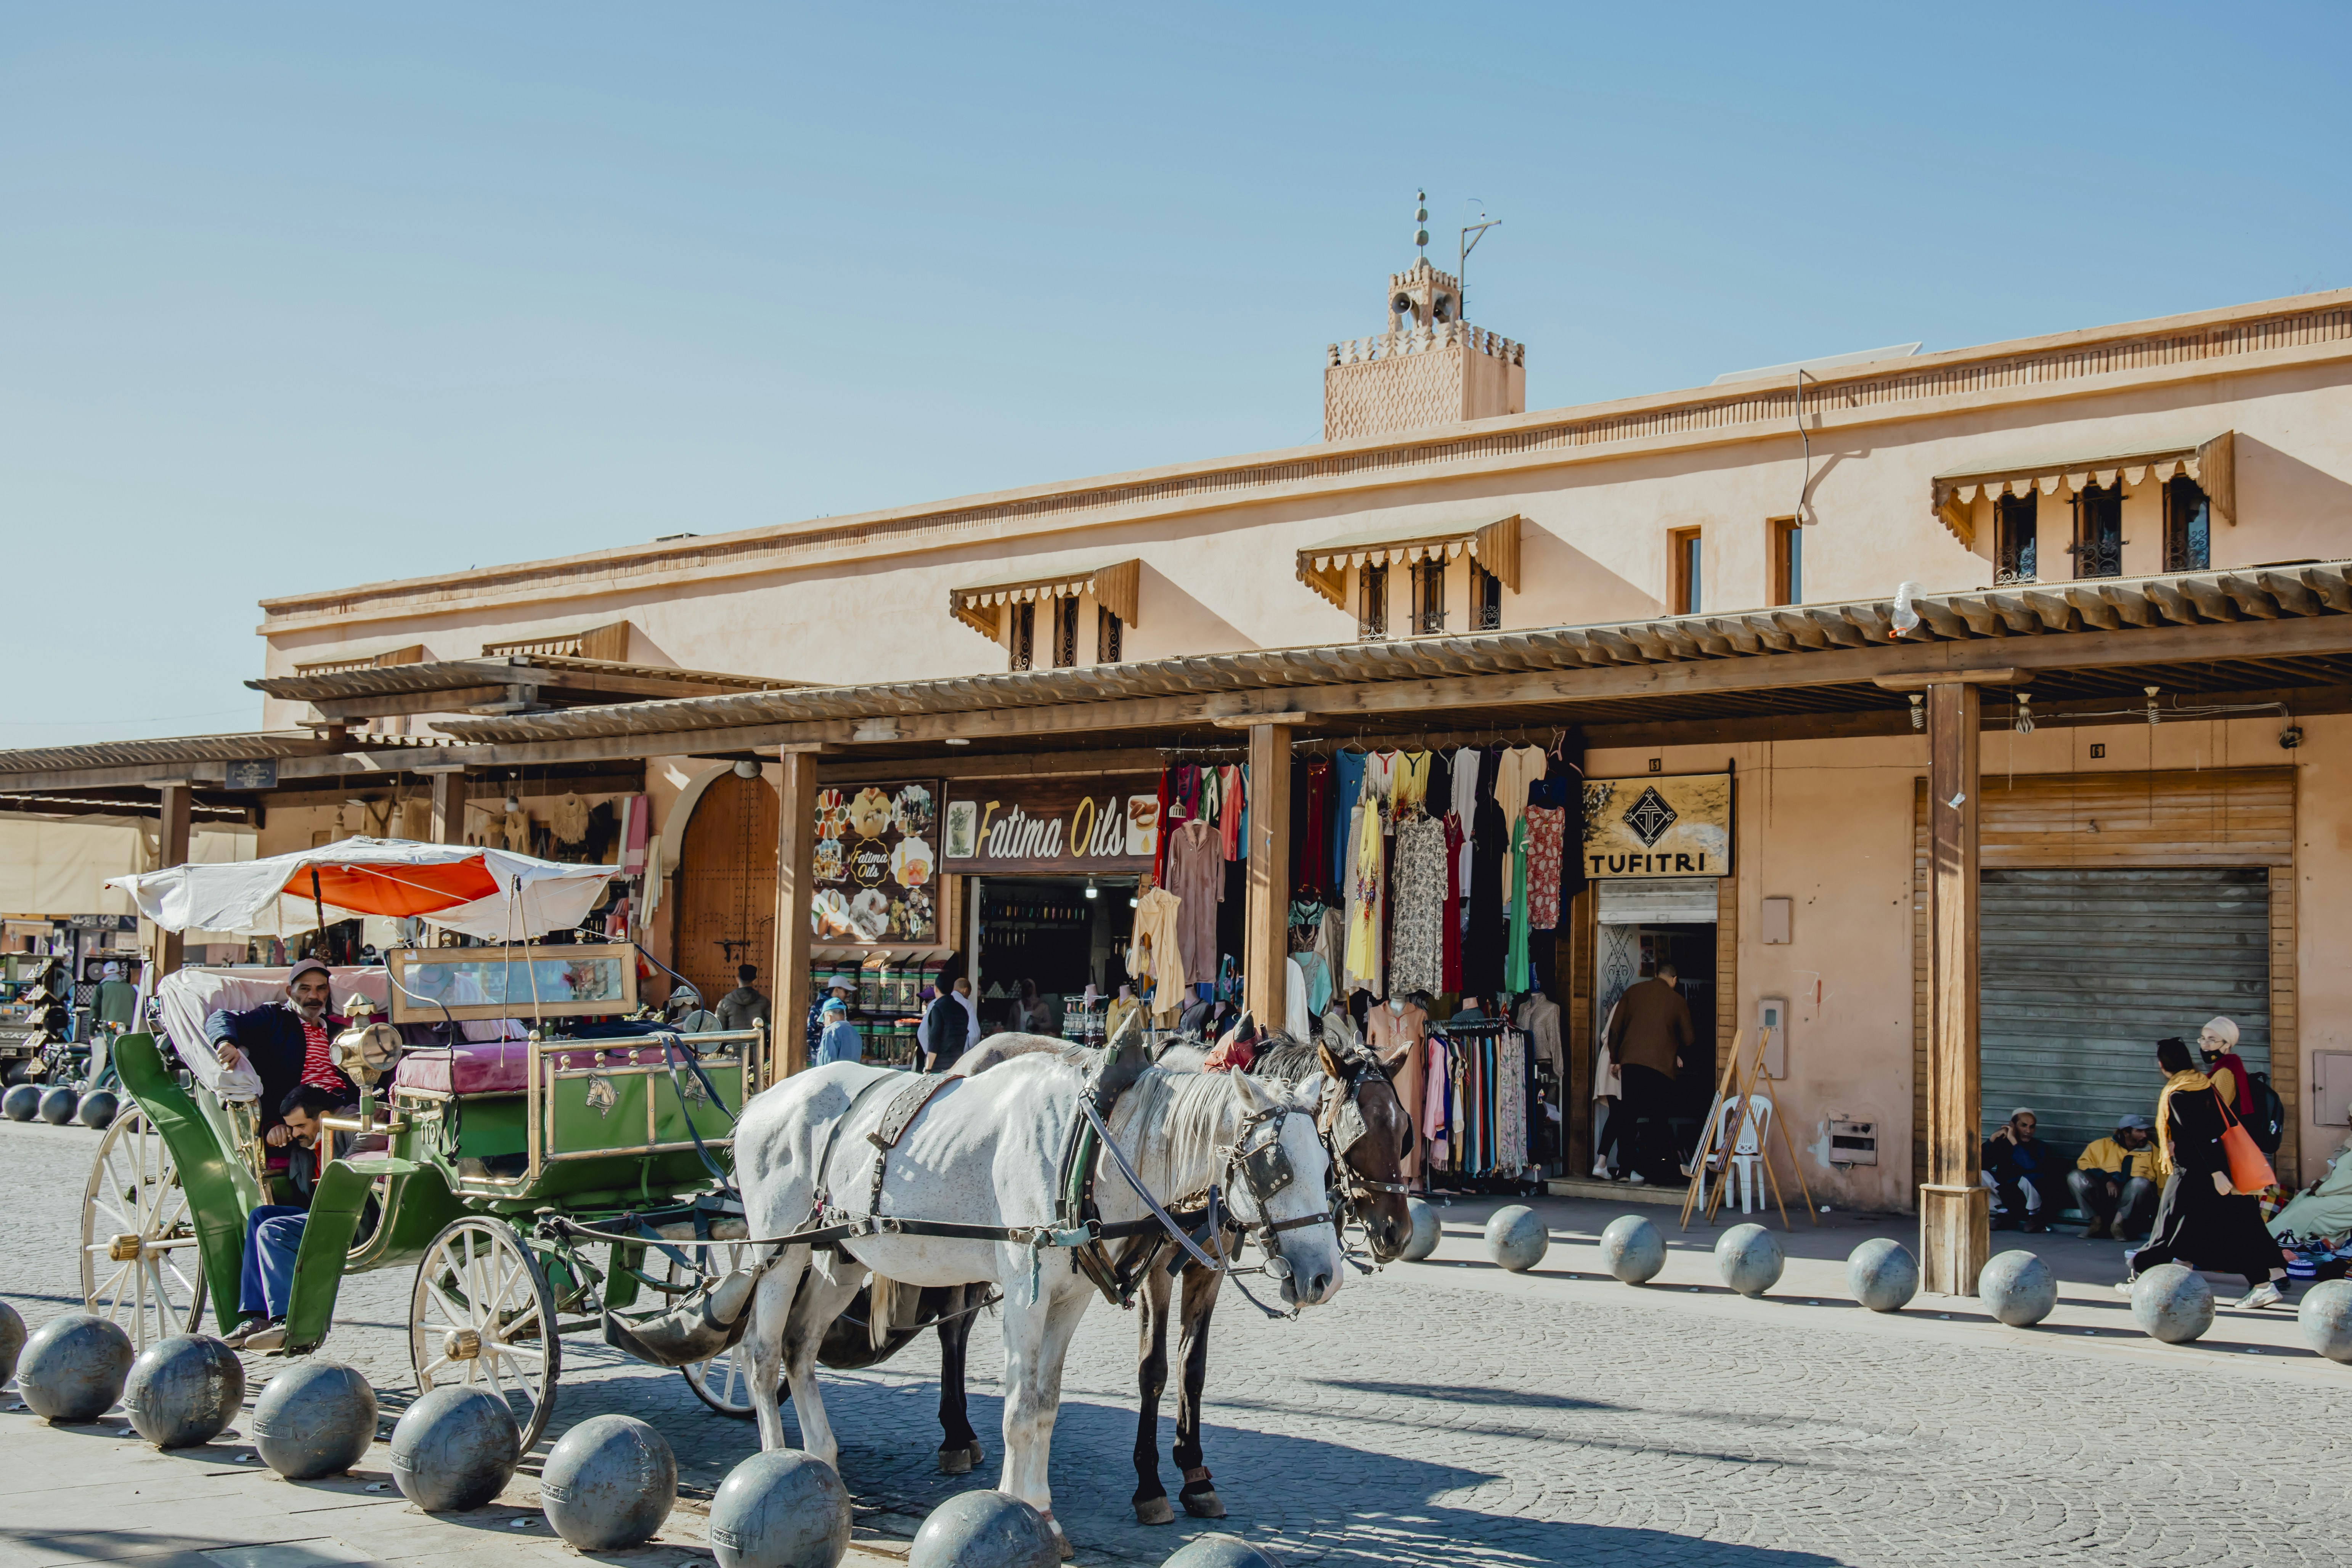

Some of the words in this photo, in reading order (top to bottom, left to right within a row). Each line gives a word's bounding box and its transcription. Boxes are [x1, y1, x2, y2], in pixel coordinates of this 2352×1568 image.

[2094, 746, 2099, 757] 6
[1653, 761, 1657, 769] 5
[975, 800, 1063, 859] Fatima
[1070, 796, 1124, 858] Oils
[852, 850, 888, 864] Fatima
[1589, 852, 1705, 873] TUFITRI
[857, 864, 879, 878] Oils
[421, 1123, 437, 1145] 119
